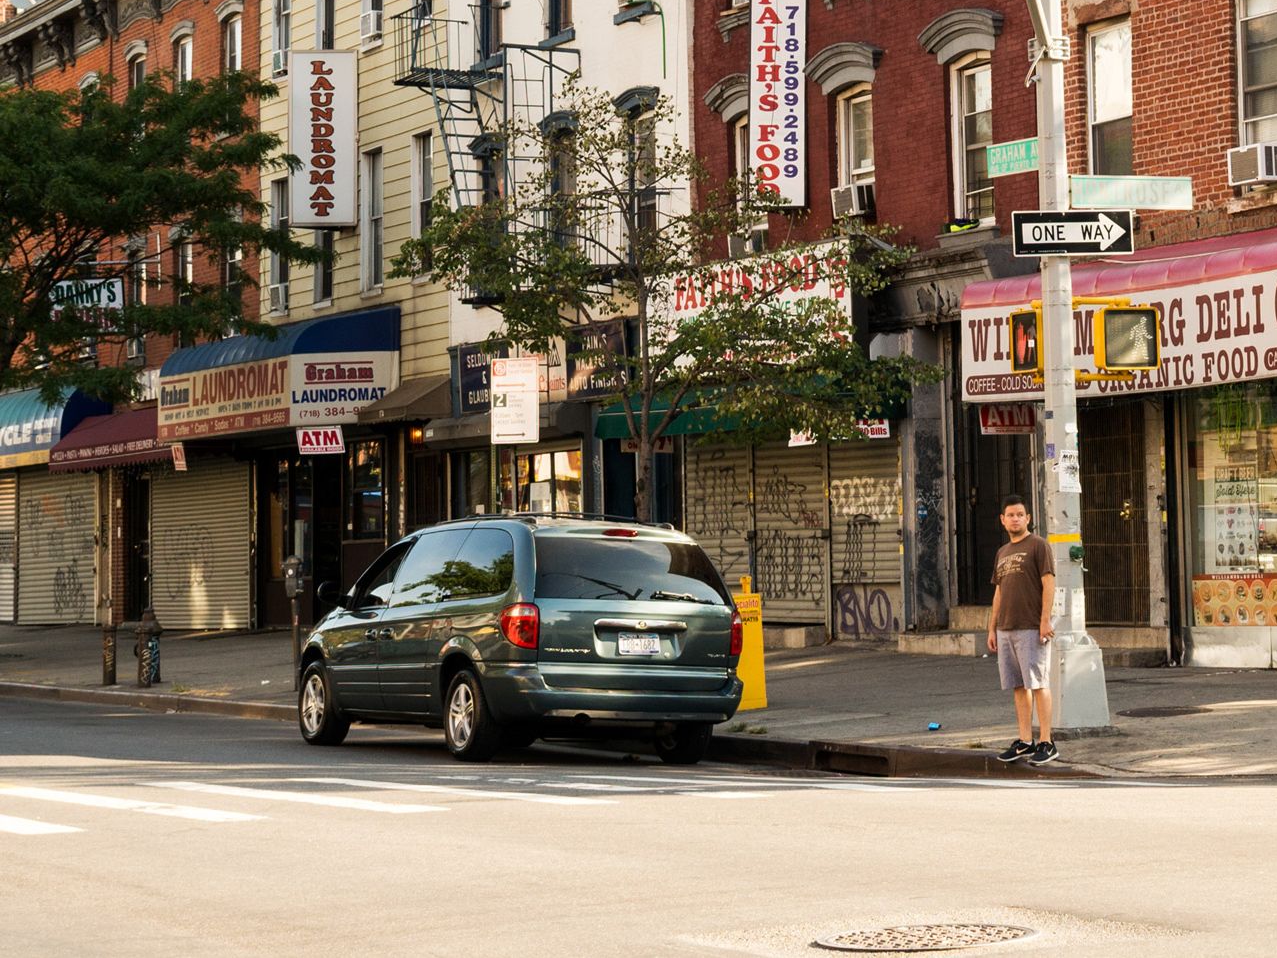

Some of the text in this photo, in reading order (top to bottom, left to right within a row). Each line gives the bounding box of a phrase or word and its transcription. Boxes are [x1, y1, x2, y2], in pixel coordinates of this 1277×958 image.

[310, 60, 336, 217] LAUNDROMAT
[1032, 224, 1114, 241] ONE WAY
[55, 281, 116, 305] DANNY'S
[1195, 284, 1265, 343] DELI
[306, 364, 374, 381] Graham
[1202, 346, 1258, 383] FOOD
[161, 360, 288, 407] Graham LAUNDROMAT
[968, 377, 996, 393] COFFEE
[1000, 375, 1020, 391] COLD
[292, 387, 386, 404] LAUNDROMAT
[468, 390, 492, 405] GLAUB
[495, 394, 504, 407] 2
[299, 409, 320, 419] (718)
[986, 404, 1029, 426] ATM
[301, 430, 340, 446] ATM
[870, 427, 888, 436] Bills
